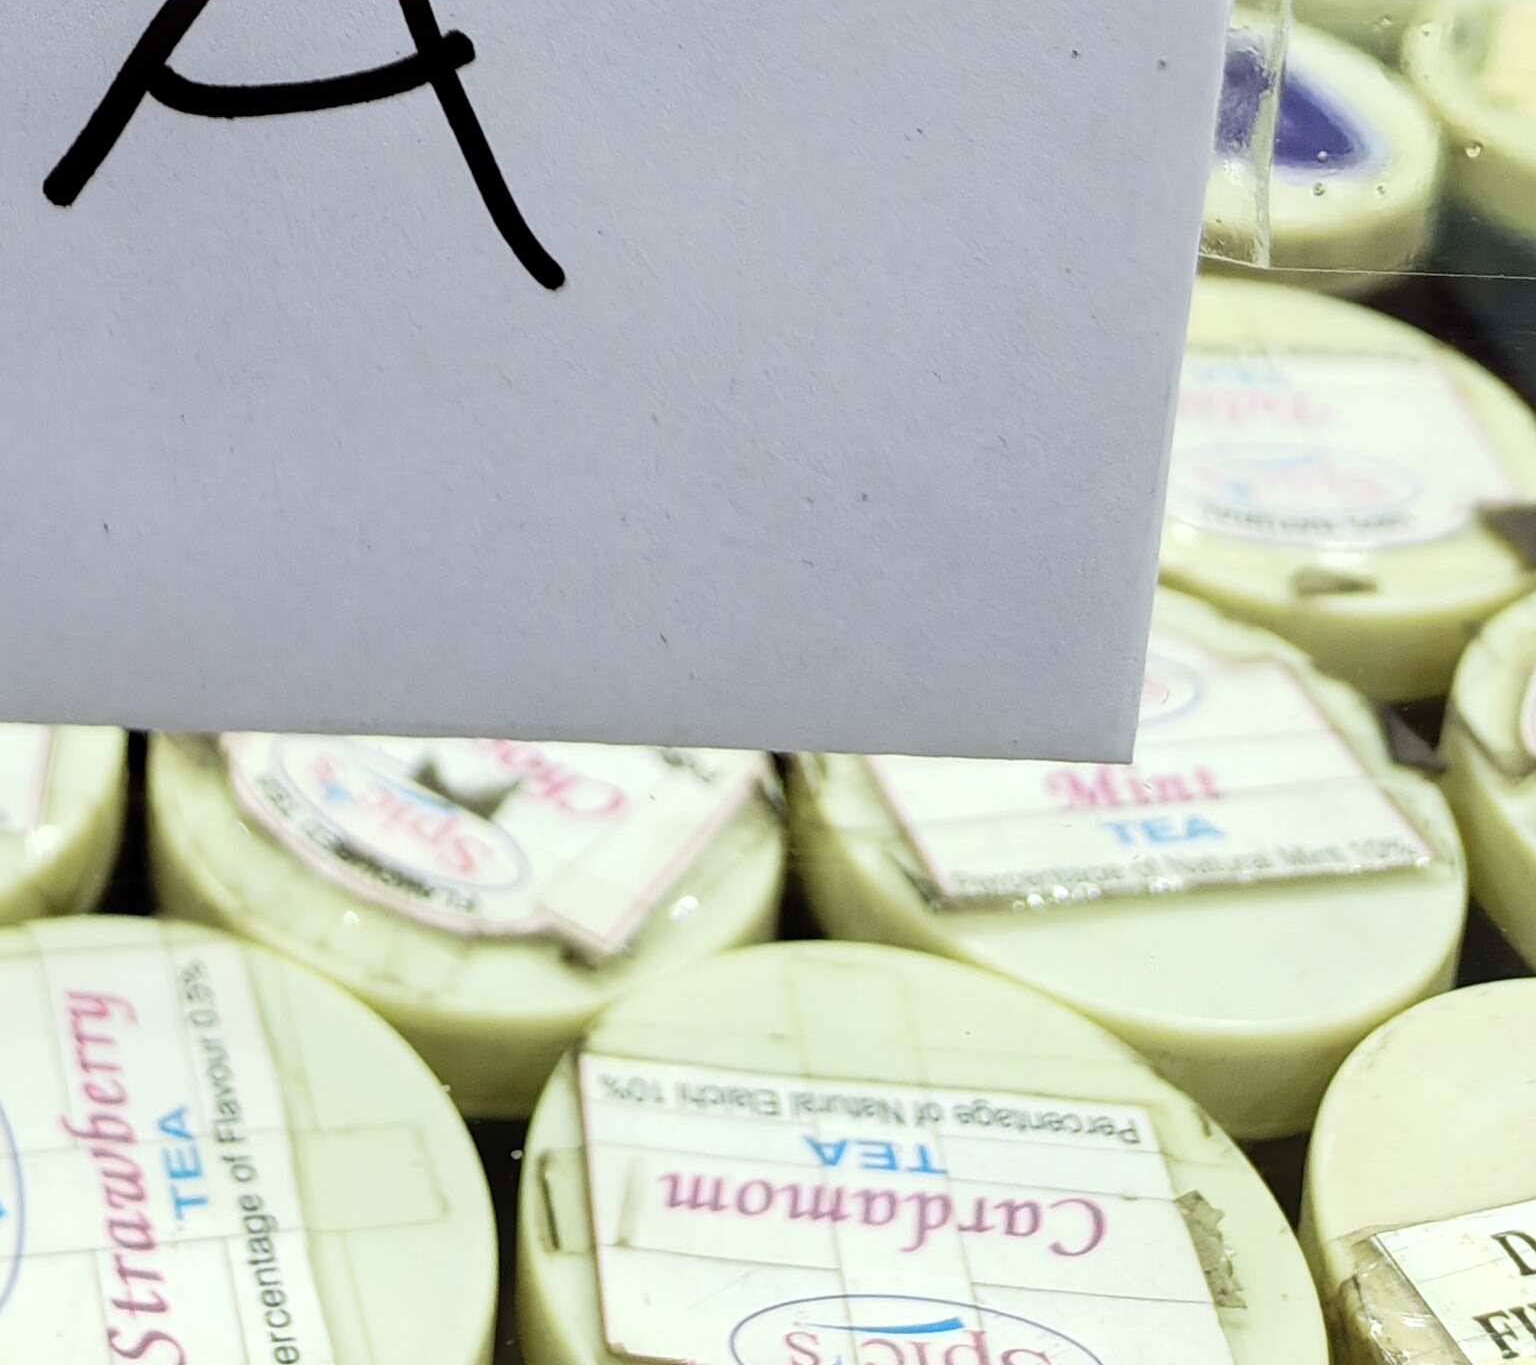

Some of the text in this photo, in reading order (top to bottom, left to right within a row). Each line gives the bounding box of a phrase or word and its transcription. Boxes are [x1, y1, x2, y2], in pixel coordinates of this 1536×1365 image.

[1044, 766, 1222, 808] Mint
[1104, 815, 1224, 846] TEA
[200, 1035, 251, 1146] Flavour
[600, 1073, 666, 1105] 10%
[791, 1091, 904, 1128] Natural
[913, 1099, 946, 1129] of
[952, 1098, 1142, 1146] Percentage
[156, 1104, 209, 1220] TEA
[221, 1149, 258, 1184] of
[802, 1134, 949, 1175] TEA
[61, 989, 186, 1365] Strawberry
[659, 1170, 1106, 1257] Cardamom
[238, 1194, 302, 1365] ercentage
